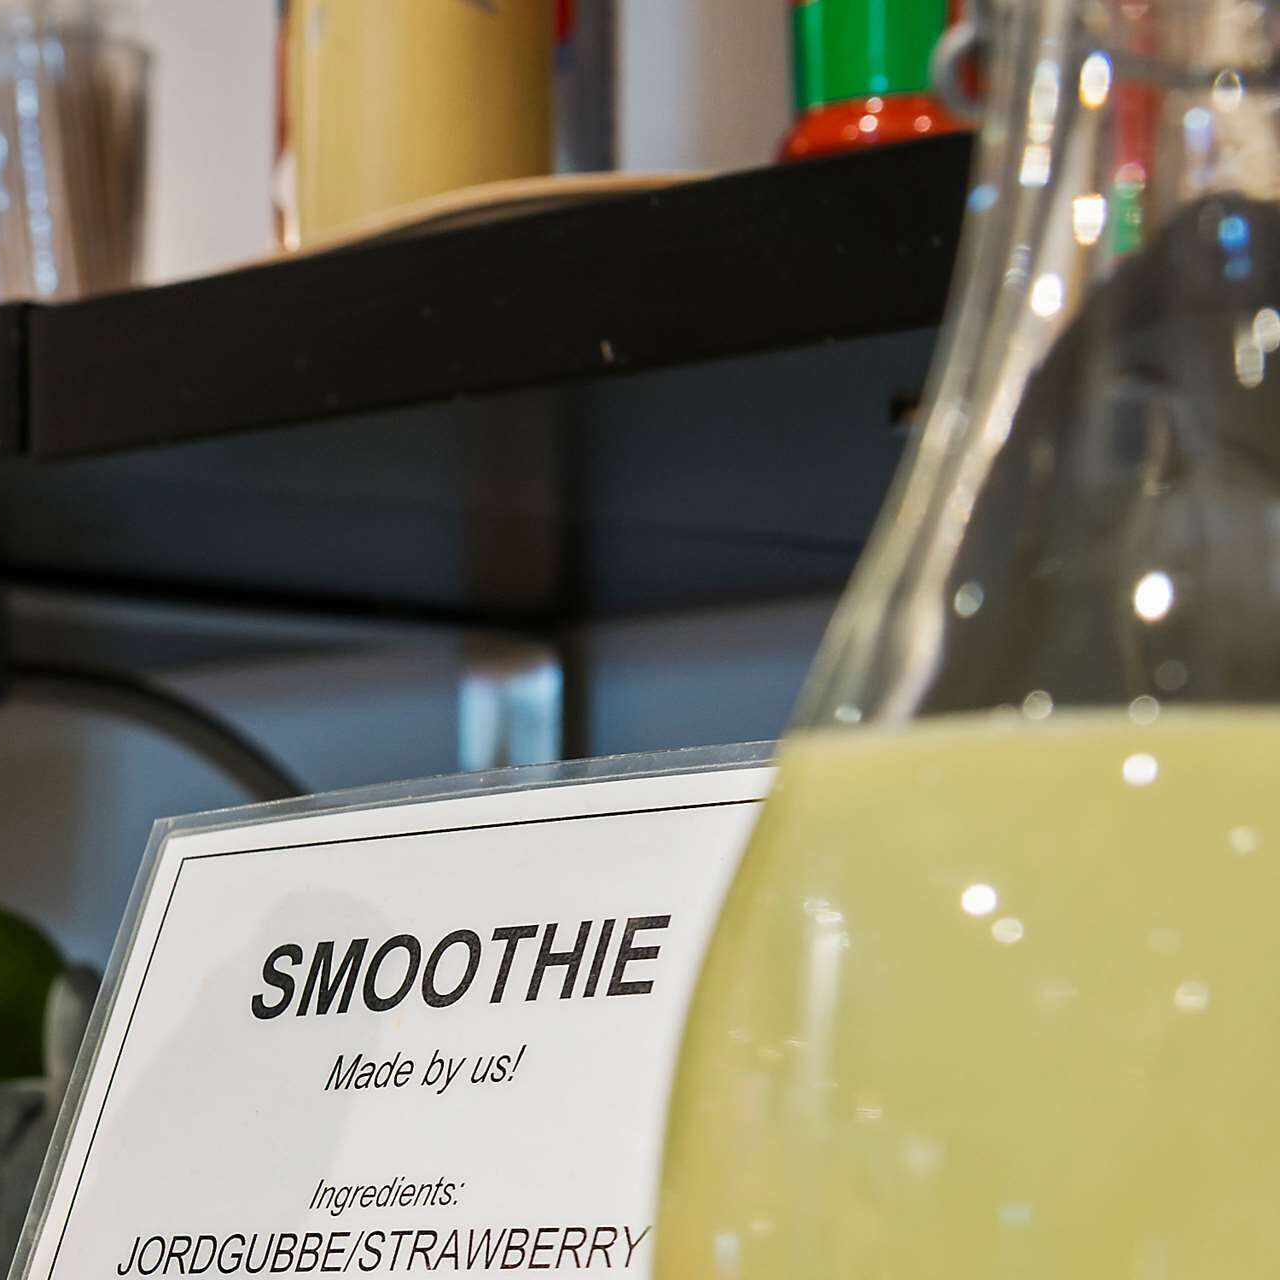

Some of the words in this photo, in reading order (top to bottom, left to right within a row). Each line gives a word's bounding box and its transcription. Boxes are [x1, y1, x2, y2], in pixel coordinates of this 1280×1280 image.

[251, 914, 672, 1021] SMOOTHIE
[324, 1051, 415, 1091] Made
[420, 1049, 467, 1095] by
[470, 1044, 527, 1084] us!
[309, 1176, 466, 1217] Ingredients:
[116, 1226, 652, 1276] JORDGUBBE/STRAWBERRY
